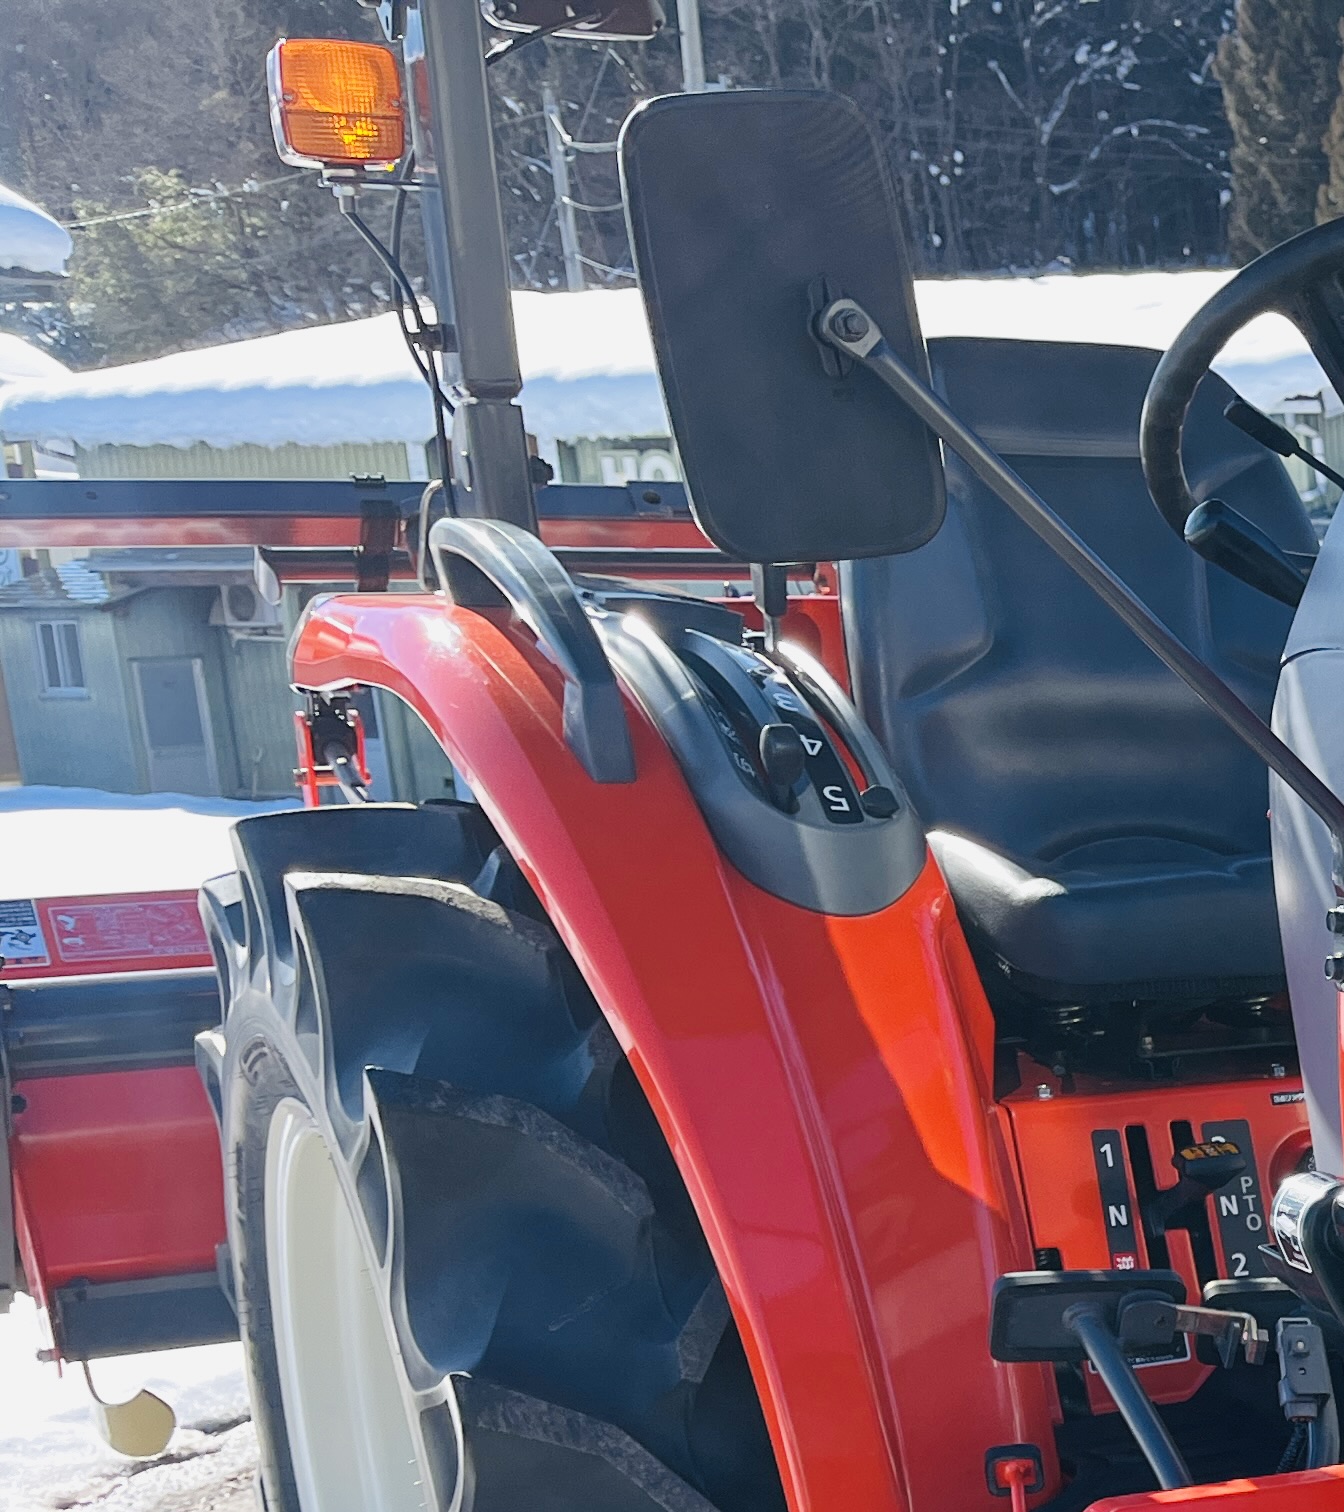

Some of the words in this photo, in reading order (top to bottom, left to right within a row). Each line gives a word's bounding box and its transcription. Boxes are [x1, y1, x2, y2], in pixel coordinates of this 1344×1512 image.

[799, 734, 822, 756] 4
[823, 786, 850, 812] 5
[1100, 1143, 1114, 1168] 1
[1108, 1205, 1128, 1227] N
[1219, 1195, 1239, 1217] N
[1231, 1253, 1250, 1277] 2
